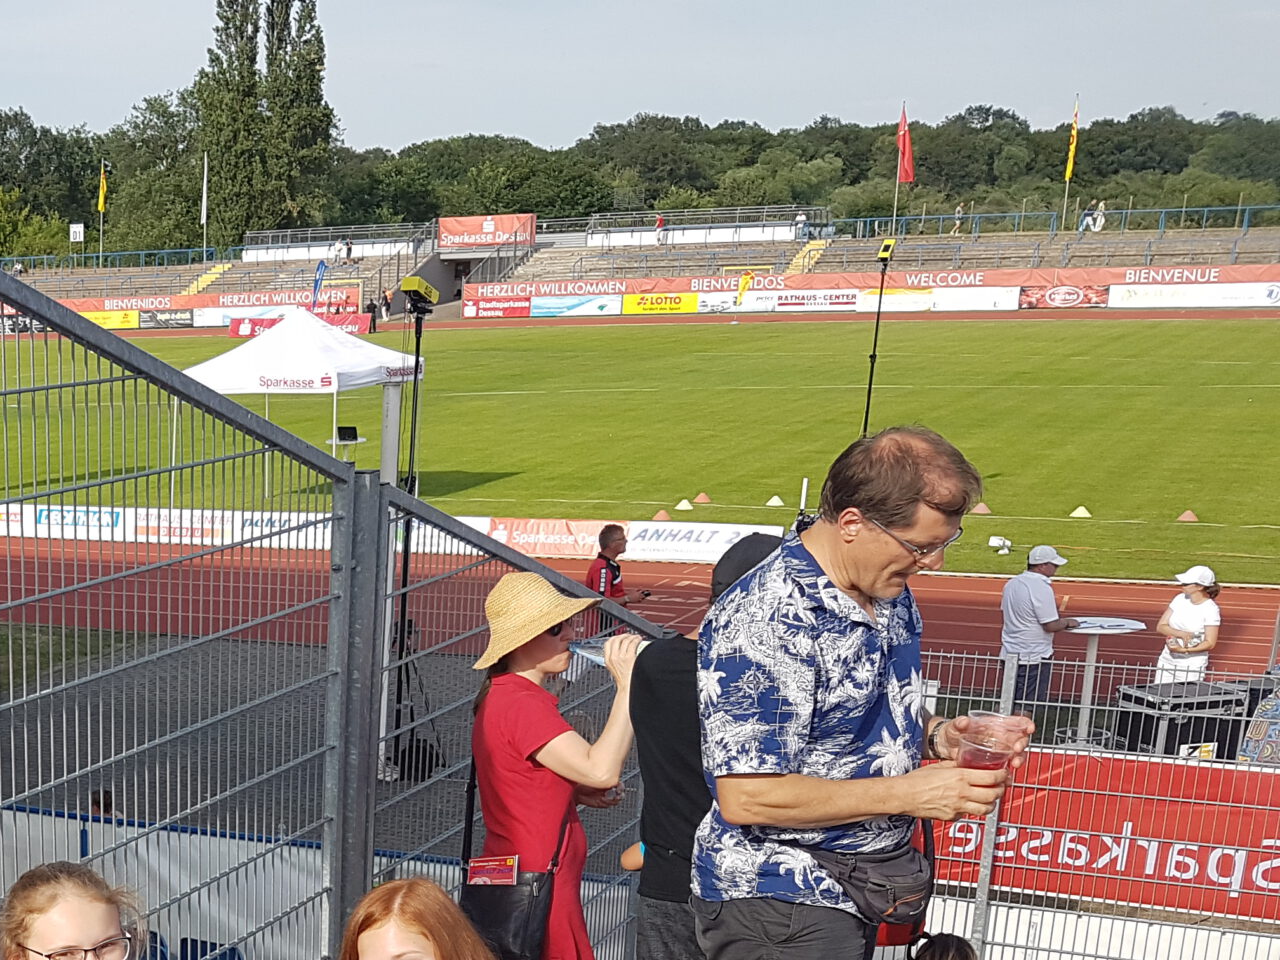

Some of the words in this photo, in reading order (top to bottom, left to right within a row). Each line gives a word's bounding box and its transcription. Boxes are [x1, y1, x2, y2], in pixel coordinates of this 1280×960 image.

[441, 230, 493, 245] Sparkasse
[906, 272, 984, 286] WELCOME
[1125, 268, 1220, 283] BIENVENUE
[478, 282, 536, 297] HERZLICH
[539, 281, 627, 295] WILLKOMMEN
[690, 276, 785, 291] BIENVEIDOS
[104, 297, 171, 310] BIENVENIDOS
[219, 293, 269, 306] HERZLICH
[479, 300, 530, 309] Stadtsparkasse
[650, 296, 682, 305] LOTTO
[479, 309, 504, 317] Dessau
[259, 375, 315, 389] Sparkasse
[512, 529, 575, 545] Sparkasse
[632, 527, 719, 544] ANHALT
[724, 530, 741, 544] 2
